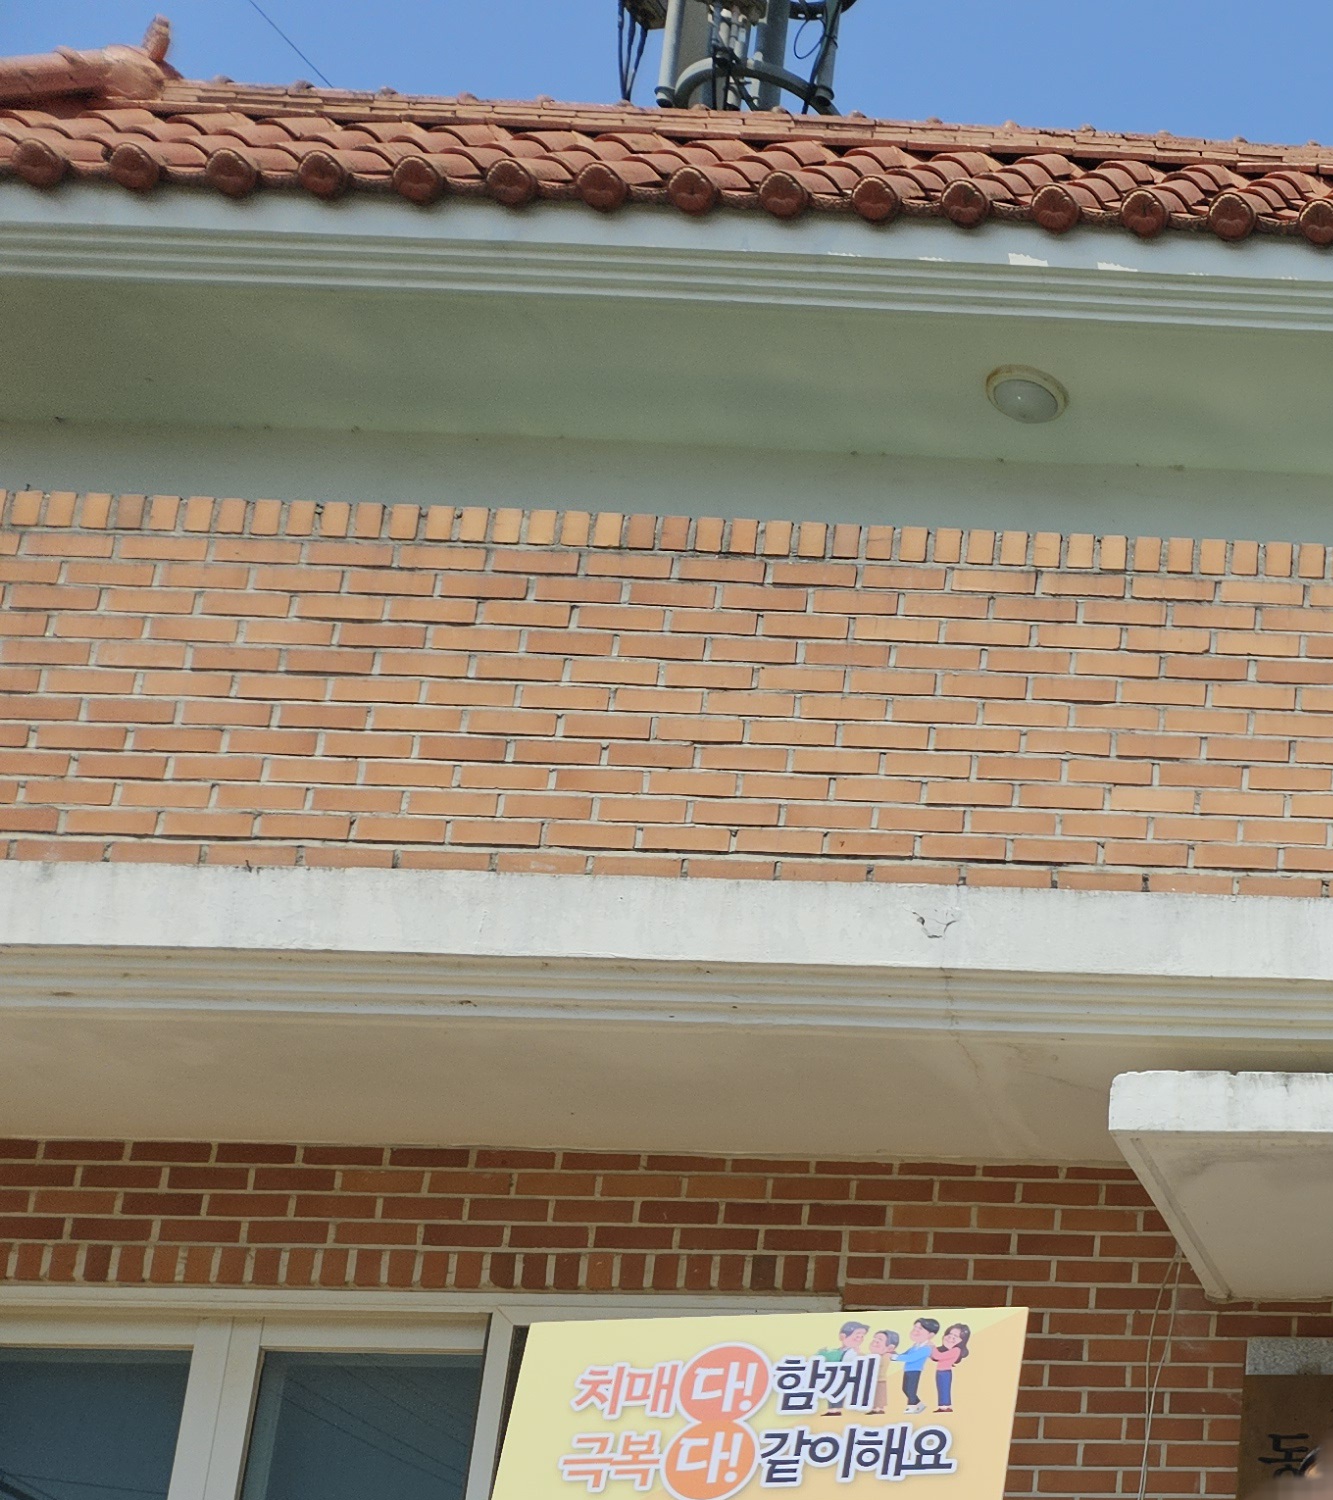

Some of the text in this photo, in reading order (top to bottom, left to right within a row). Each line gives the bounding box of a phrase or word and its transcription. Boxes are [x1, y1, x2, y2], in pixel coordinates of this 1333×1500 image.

[578, 1363, 679, 1416] 치매
[775, 1356, 877, 1411] 함께
[563, 1434, 658, 1489] 극복
[762, 1427, 953, 1484] 같이해요
